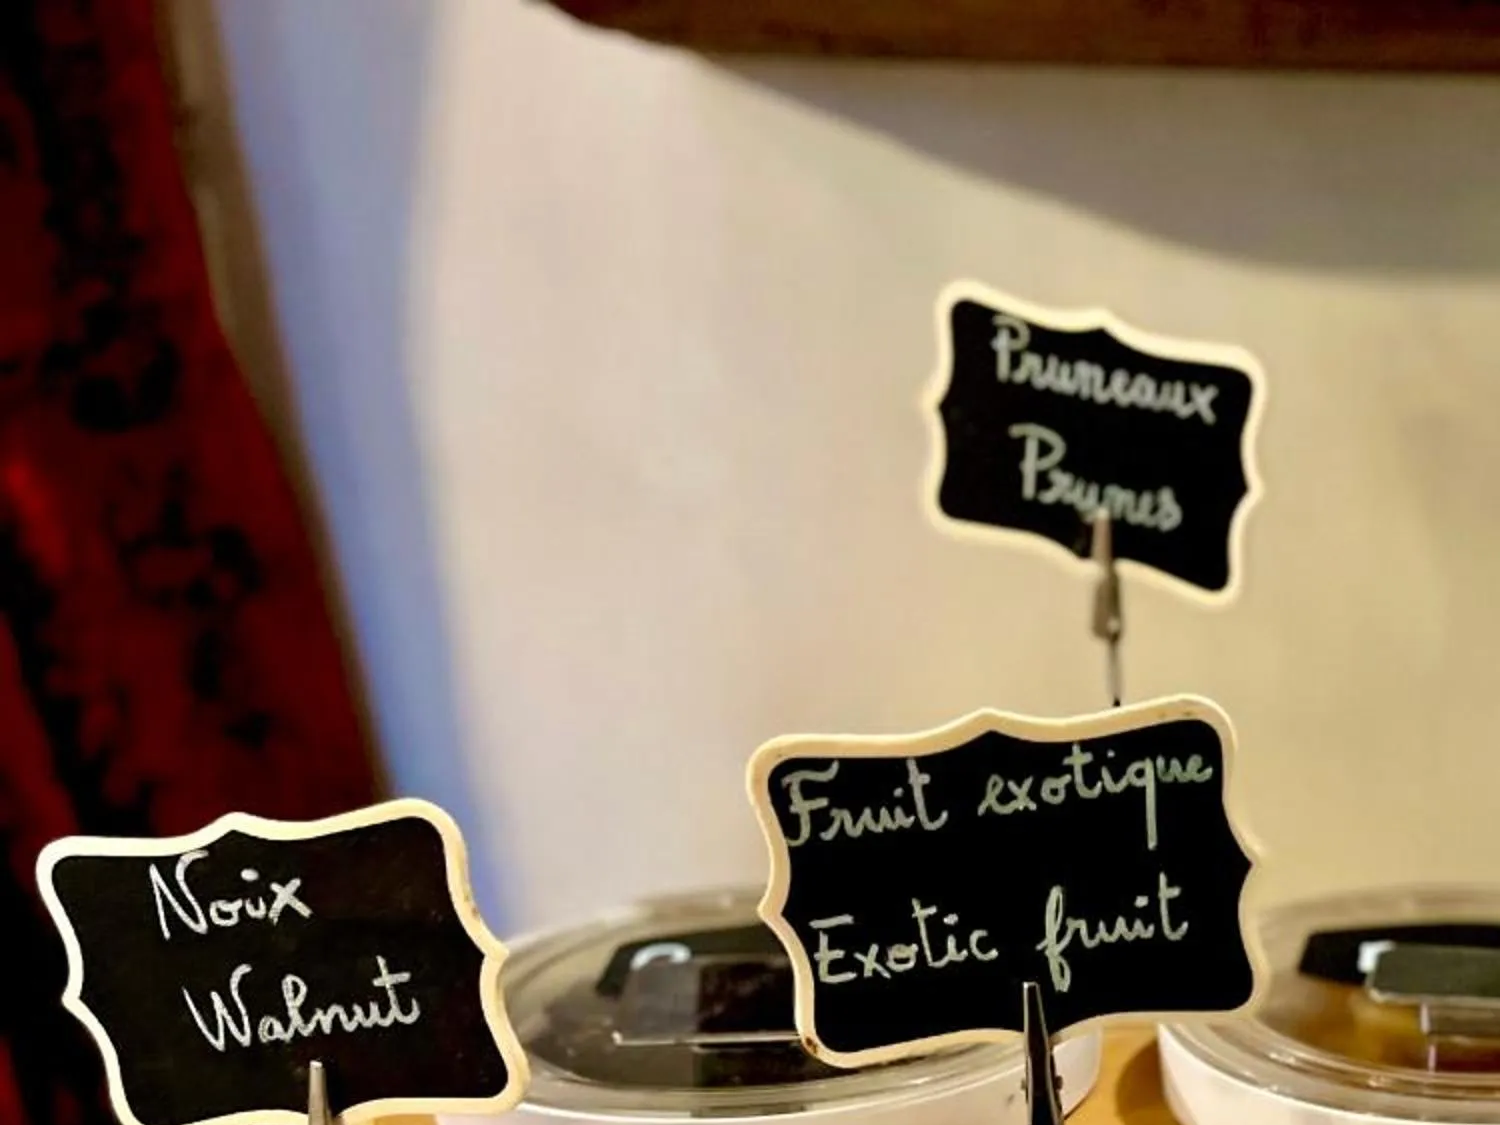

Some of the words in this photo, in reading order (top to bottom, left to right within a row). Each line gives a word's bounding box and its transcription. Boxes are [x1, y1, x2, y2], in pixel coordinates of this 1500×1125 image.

[990, 314, 1219, 425] Pruneaux
[1007, 421, 1184, 533] Prunes
[782, 757, 949, 847] Fruit
[977, 742, 1213, 851] exotique
[148, 849, 313, 940] Noix
[808, 898, 999, 984] Exotic
[1035, 872, 1189, 993] fruit
[181, 955, 421, 1052] Walnut
